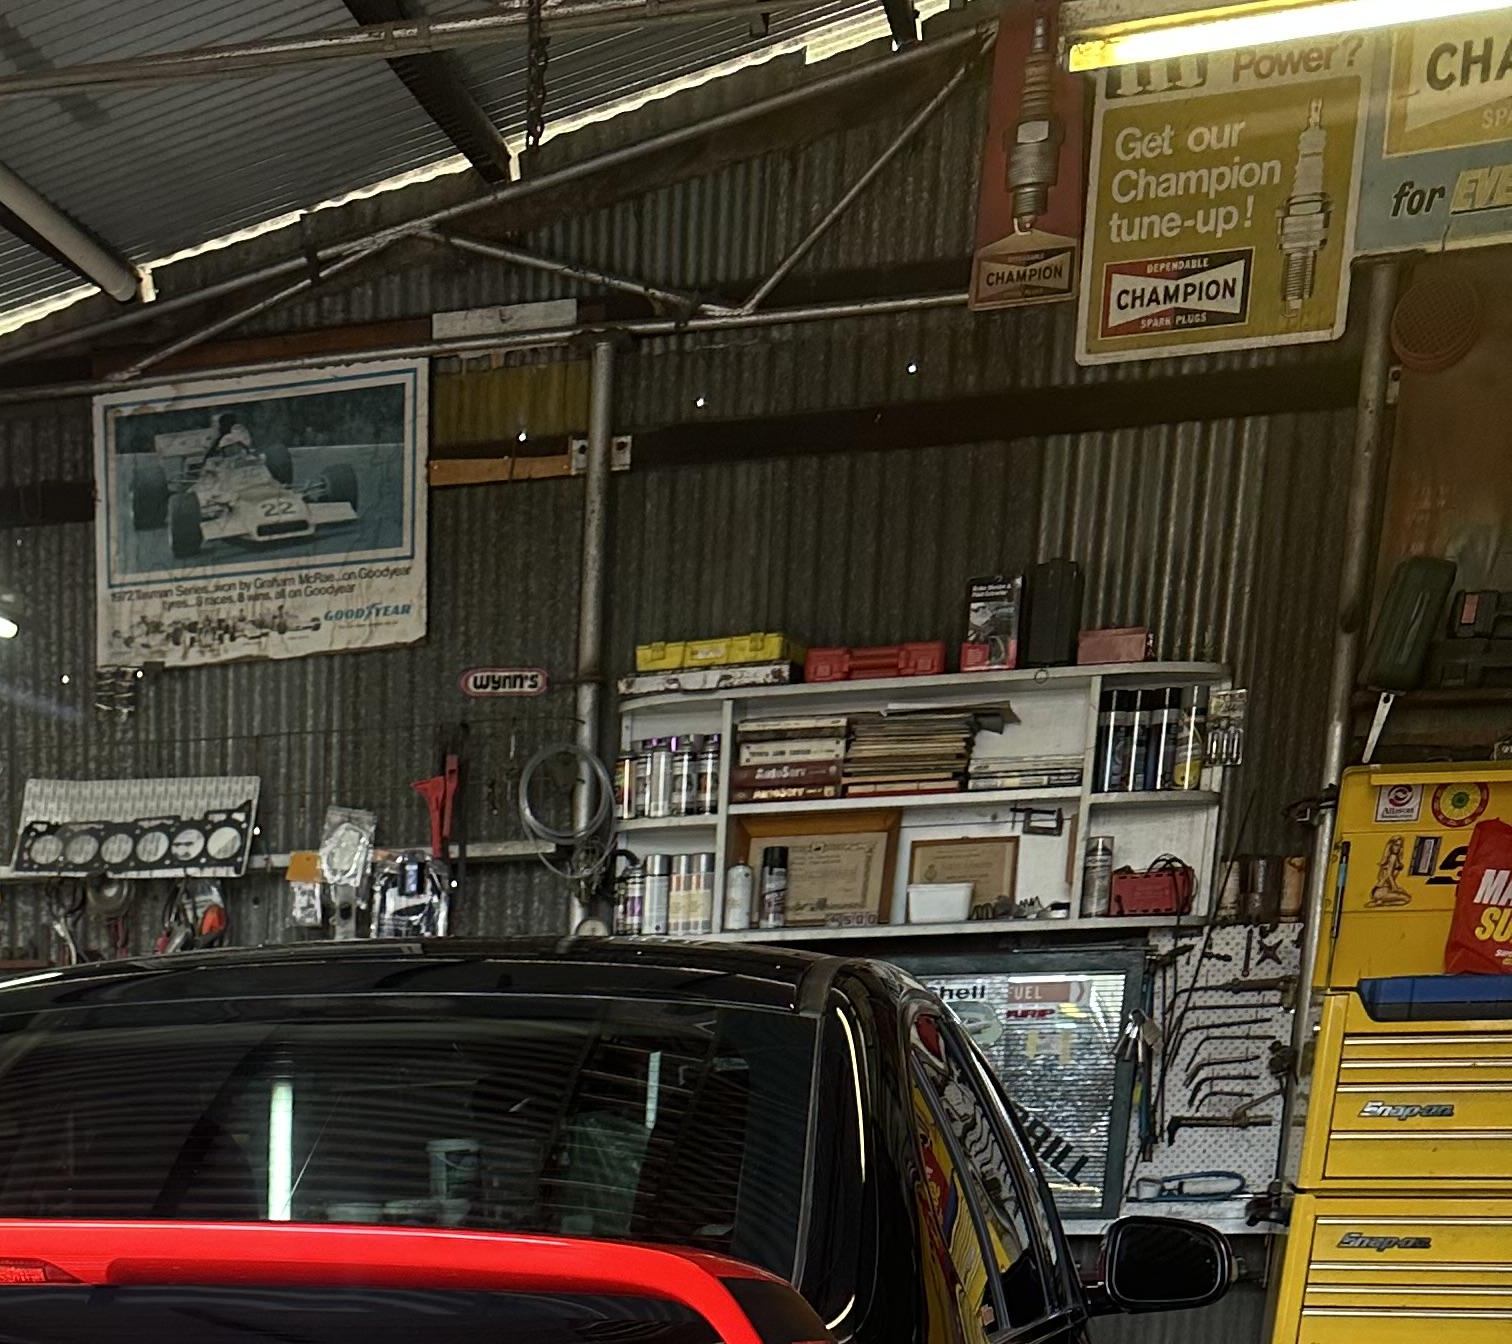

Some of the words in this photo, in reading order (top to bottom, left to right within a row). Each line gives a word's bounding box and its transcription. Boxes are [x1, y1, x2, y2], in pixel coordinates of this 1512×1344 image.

[1233, 35, 1365, 82] Power?
[1115, 123, 1175, 161] Get
[1187, 120, 1246, 152] our
[1111, 156, 1281, 204] Champion
[1391, 180, 1446, 217] for
[1109, 195, 1254, 243] tune-up!
[986, 264, 1064, 287] CHAMPION
[1146, 257, 1210, 274] DEPENDABLE
[1116, 277, 1237, 311] CHAMPION
[1139, 317, 1171, 330] SPARK
[1175, 312, 1207, 325] PLUGS
[260, 502, 297, 517] 22
[239, 580, 251, 592] by
[254, 575, 295, 589] Graham
[358, 565, 412, 580] Goodyear
[288, 588, 302, 598] on
[304, 582, 356, 598] Goodyear
[323, 601, 412, 621] GOODYEAR
[1358, 1100, 1455, 1120] Snap-on
[1336, 1231, 1432, 1252] Snap-on
